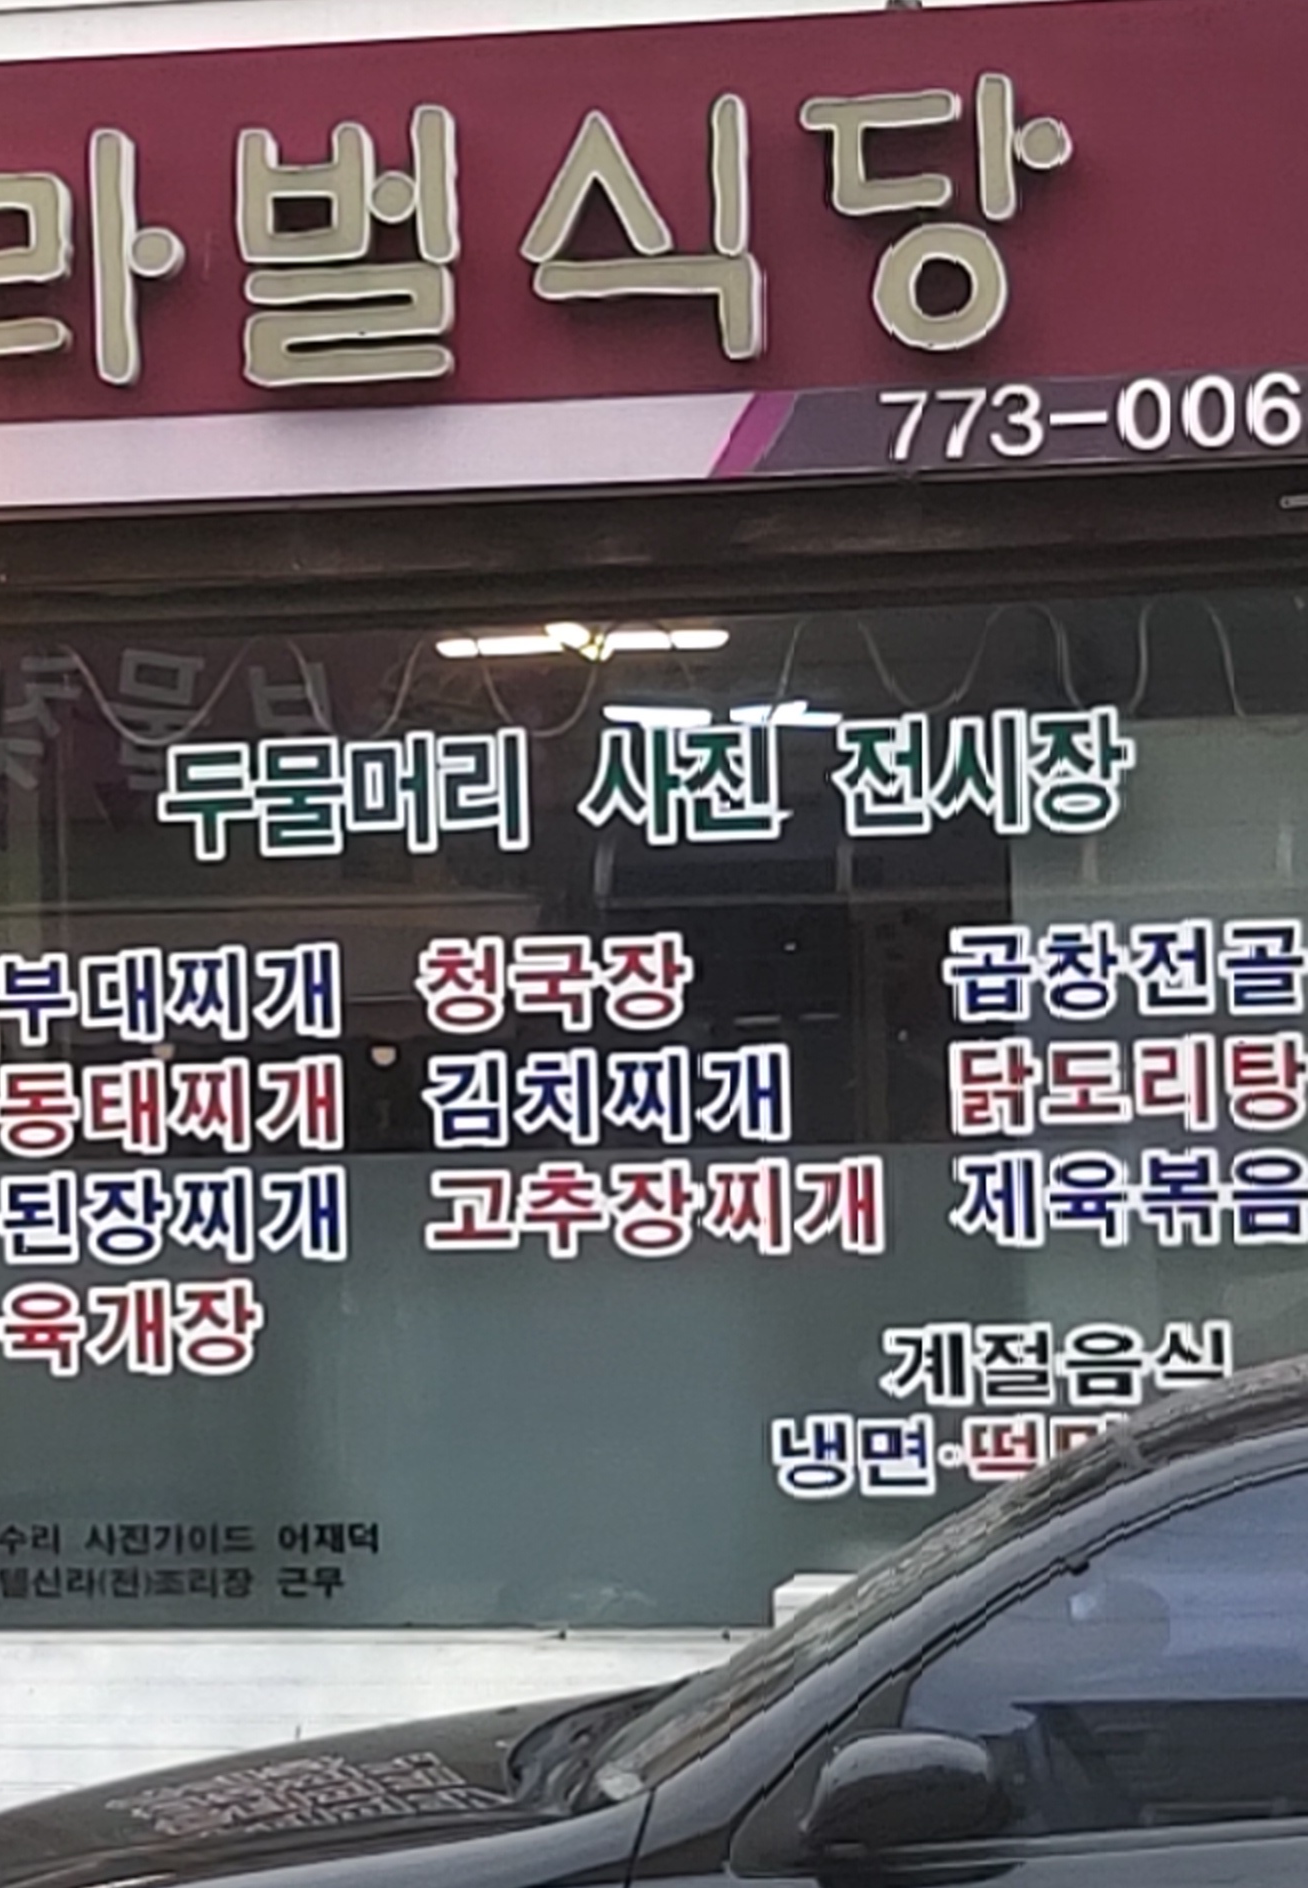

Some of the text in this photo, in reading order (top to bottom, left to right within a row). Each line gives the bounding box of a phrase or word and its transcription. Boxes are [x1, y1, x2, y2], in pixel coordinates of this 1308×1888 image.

[157, 705, 1136, 861] 두물머리 사진 전시장
[416, 932, 694, 1034] 청국장
[944, 919, 1308, 1023] 곱창전골
[423, 1043, 791, 1148] 김치찌개
[950, 1032, 1308, 1135] 닭도리탕
[425, 1155, 886, 1258] 고추장찌개
[949, 1149, 1308, 1247] 제육볶음
[881, 1319, 1234, 1406] 계절음식
[84, 1522, 256, 1556] 사진가이드
[276, 1565, 346, 1599] 근무
